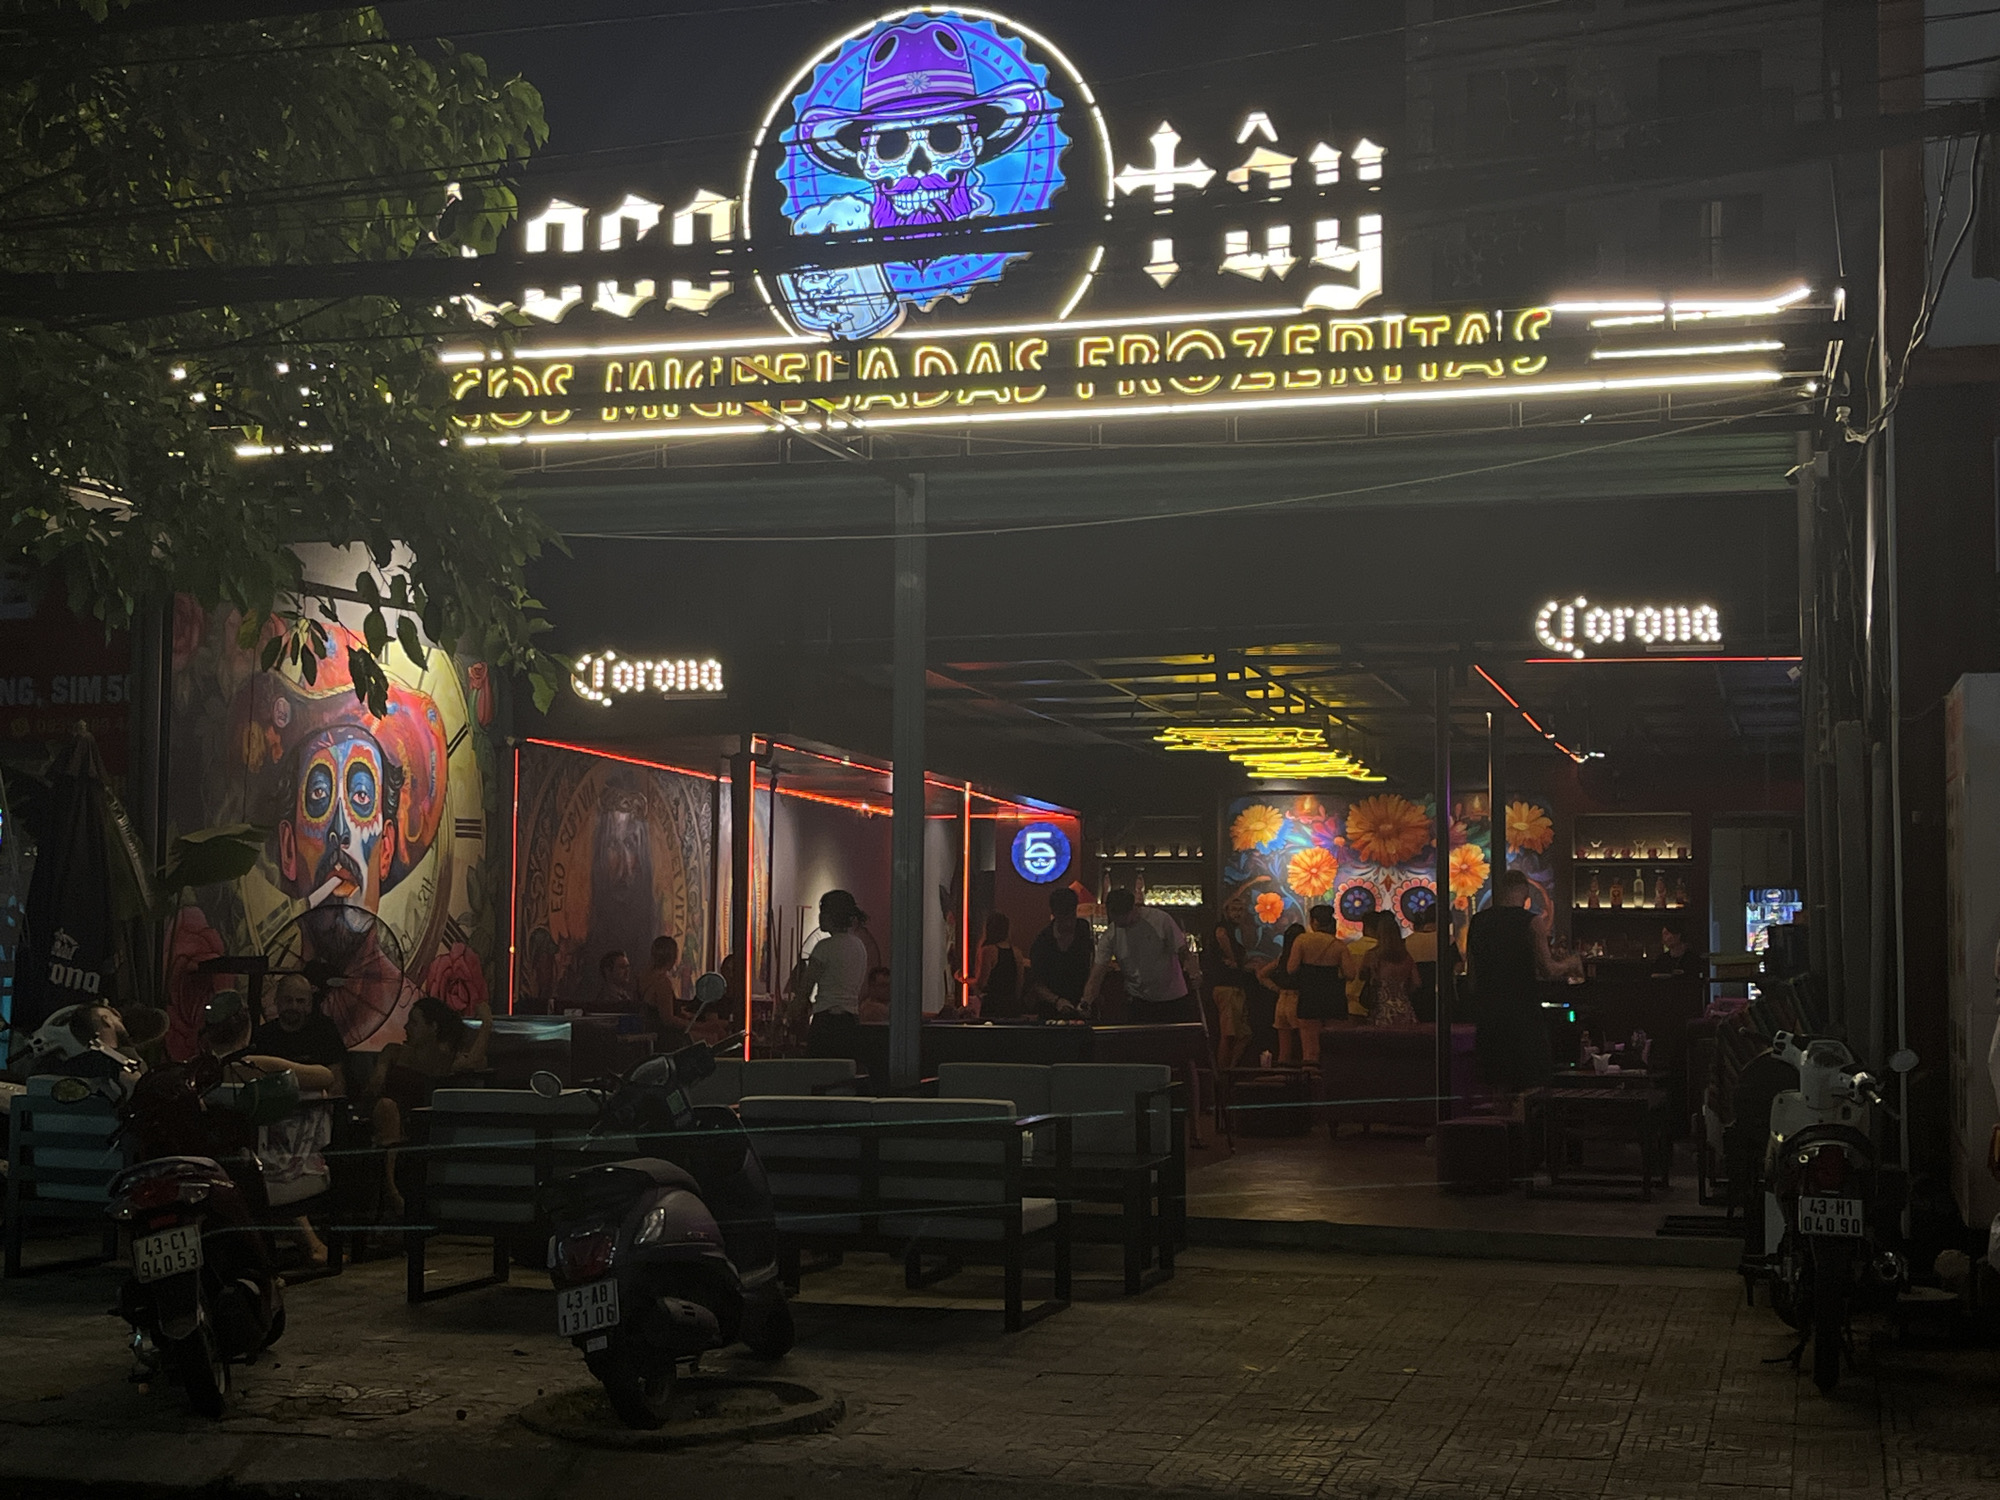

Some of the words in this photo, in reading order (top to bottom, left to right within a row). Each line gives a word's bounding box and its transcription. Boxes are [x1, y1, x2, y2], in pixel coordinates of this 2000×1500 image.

[1534, 595, 1722, 660] Corona
[570, 649, 724, 708] Corona
[141, 1248, 198, 1279] 940.53
[144, 1231, 188, 1258] 43-C1
